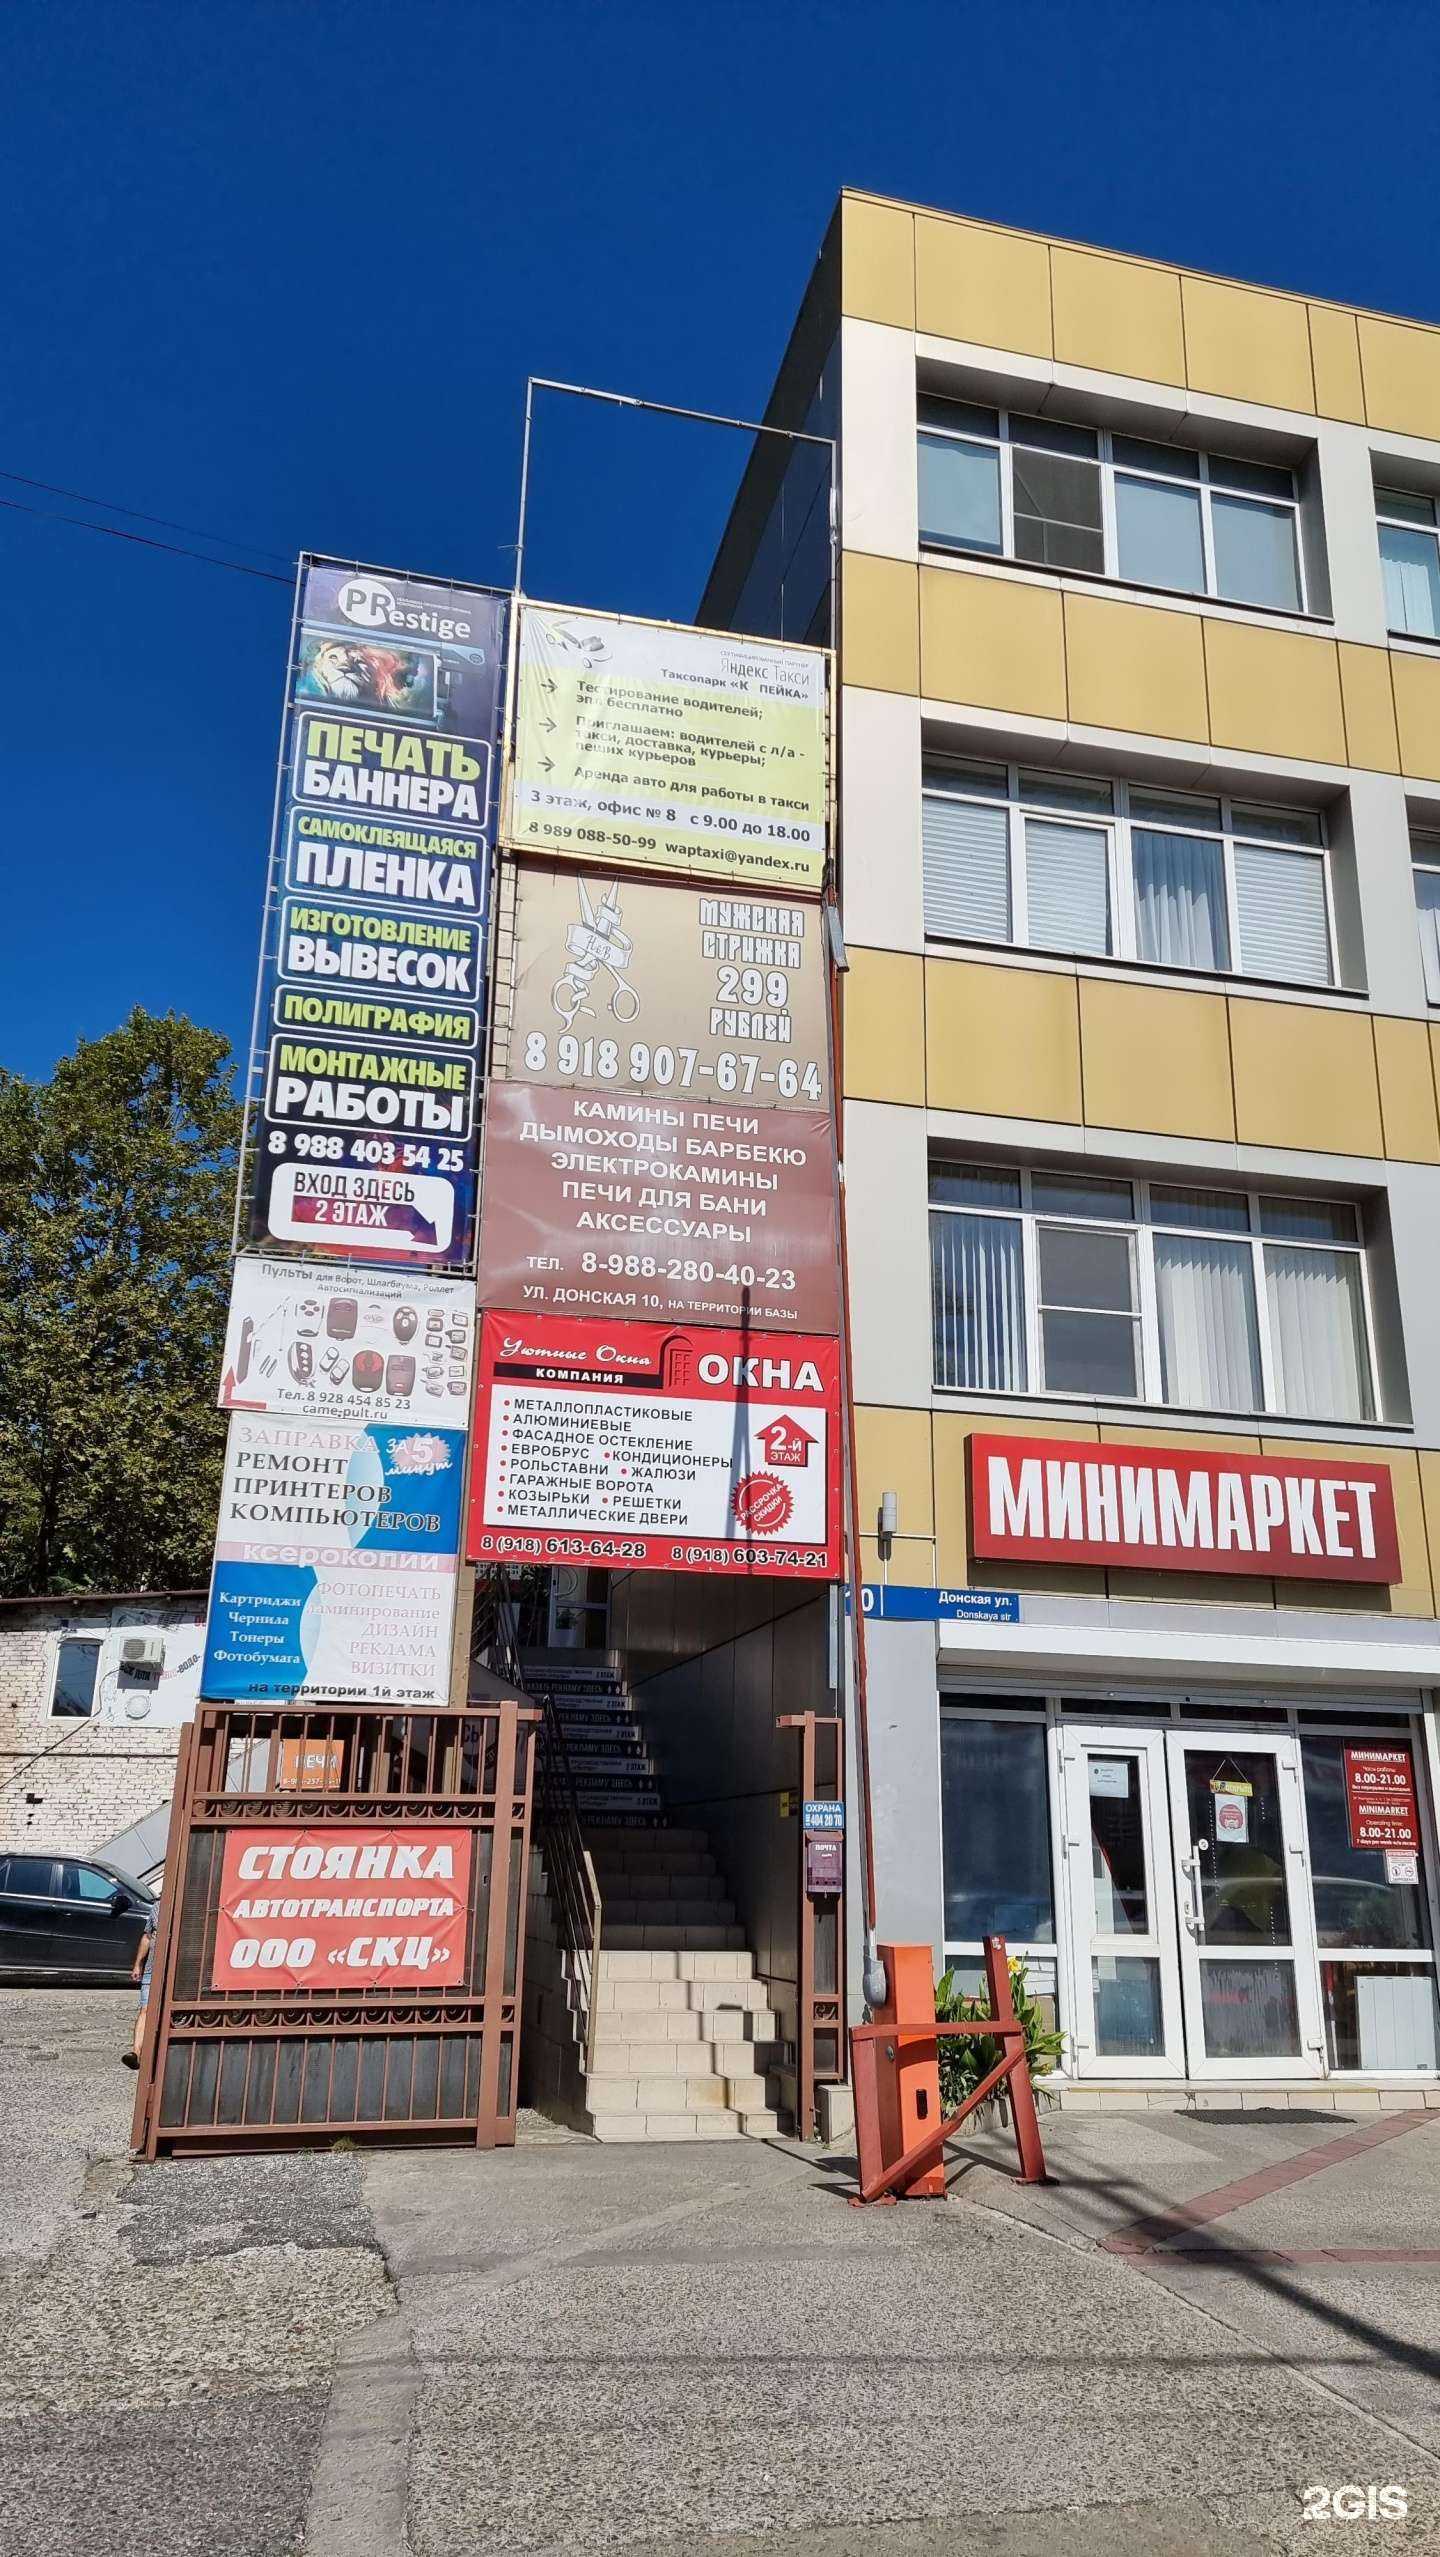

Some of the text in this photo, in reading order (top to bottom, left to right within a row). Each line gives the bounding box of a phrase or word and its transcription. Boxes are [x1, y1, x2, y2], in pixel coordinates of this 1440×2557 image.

[343, 587, 472, 639] PRestige
[662, 669, 726, 687] Таксопарк
[721, 658, 768, 679] Яндекс
[775, 666, 809, 685] Такси
[607, 697, 683, 717] бесплатно
[683, 697, 763, 720] водителей;
[307, 721, 481, 781] ПЕЧАТЬ
[625, 736, 765, 767] доставка, курьеры;
[629, 746, 696, 766] курьеров
[680, 731, 795, 758] водителей с л/а
[303, 760, 479, 821] БАННЕРА
[575, 767, 809, 812] Аренда авто для работы в такси
[531, 790, 810, 842] 3 этаж, офис № 8 с 9.00 до 18.00
[298, 816, 476, 859] САМОКЛЕЯЩАЯСЯ
[529, 821, 809, 872] 8 989 088-50-99 waptaxi@yandex.ru
[296, 841, 475, 907] ПЛЕНКА
[291, 907, 471, 952] ИЗГОТОВЛЕНИЕ
[699, 898, 804, 937] МУЖСКАЯ
[702, 931, 801, 969] СТРИЖКА
[288, 935, 471, 992] ВЫВЕСОК
[716, 965, 788, 1008] 299
[284, 995, 469, 1040] ПОЛИГРАФИЯ
[709, 1006, 792, 1043] РУБЛЕЙ
[280, 1045, 466, 1091] МОНТАЖНЫЕ
[525, 1030, 823, 1101] 8 918 907-67-64
[275, 1077, 463, 1132] РАБОТЫ
[574, 1100, 759, 1135] КАМИНЫ ПЕЧИ
[268, 1131, 464, 1172] 8 988 403 54 25
[520, 1121, 806, 1166] ДЫМОХОДЫ БАРБЕКЮ
[551, 1151, 778, 1190] ЭЛЕКТРОКАМИНЫ
[294, 1172, 415, 1202] ВХОД ЗДЕСЬ
[563, 1181, 766, 1216] ПЕЧИ ДЛЯ БАНИ
[315, 1200, 388, 1227] 2 ЭТАЖ
[576, 1211, 750, 1243] АКСЕССУАРЫ
[262, 1264, 312, 1279] Пульты
[316, 1274, 333, 1282] для
[527, 1252, 796, 1290] ТЕЛ. 8-988-280-40-23
[523, 1285, 798, 1319] УЛ. ДОНСКАЯ 10, НА ТЕРРИТОРИИ БАЗЫ
[500, 1337, 587, 1360] Уютные
[536, 1368, 623, 1383] КОМПАНИЯ
[698, 1354, 825, 1392] ОКНА
[307, 1391, 315, 1401] 8
[320, 1392, 343, 1404] 928
[347, 1395, 371, 1406] 454
[375, 1398, 390, 1407] 85
[395, 1399, 410, 1409] 23
[514, 1399, 693, 1421] МЕТАЛЛОПЛАСТИКОВЫЕ
[513, 1414, 632, 1432] АЛЮМИНИЕВЫЕ
[239, 1426, 379, 1453] ЗАПРАВКА
[412, 1438, 433, 1463] 5
[512, 1429, 693, 1451] ФАСАДНОЕ ОСТЕКЛЕНИЕ
[236, 1452, 348, 1474] РЕМОНТ
[385, 1459, 453, 1476] минут
[512, 1444, 733, 1468] ЕВРОБРУС КОНДИЦИОНЕРЫ
[771, 1451, 801, 1462] ЭТАЖ
[511, 1459, 696, 1480] РОЛЬСТАВНИ ЖАЛЮЗИ
[233, 1478, 392, 1504] ПРИНТЕРОВ
[510, 1474, 653, 1493] ГАРАЖНЫЕ ВОРОТА
[509, 1489, 681, 1510] КОЗЫРЬКИ РЕШЕТКИ
[740, 1484, 782, 1520] РАССРОЧКА
[754, 1496, 782, 1521] СКИДКИ
[987, 1455, 1376, 1560] МИНИМАРКЕТ
[230, 1503, 440, 1532] КОМПЬЮТЕРОВ
[508, 1505, 688, 1525] МЕТАЛЛИЧЕСКИЕ ДВЕРИ
[481, 1536, 827, 1568] 8 (918) 613-64-28 8 (918) 603-74-21
[220, 1592, 300, 1608] Картриджи
[317, 1582, 440, 1599] ФОТОПЕЧАТЬ
[939, 1592, 1012, 1608] Донская ул.
[228, 1612, 289, 1626] Чернила
[957, 1610, 998, 1621] Donskaya
[230, 1631, 284, 1645] Тонеры
[360, 1622, 439, 1638] ДИЗАЙН
[214, 1651, 300, 1666] Фотобумага
[349, 1642, 436, 1657] РЕКЛАМА
[352, 1662, 435, 1676] ВИЗИТКИ
[249, 1682, 434, 1700] на территории 1й этаж
[1351, 1751, 1405, 1761] МИНИМАРКЕТ
[1355, 1773, 1406, 1784] 8.00-21.00
[805, 1804, 841, 1813] ОХРАНА
[1359, 1805, 1408, 1815] MINIMARKET
[1360, 1827, 1411, 1839] 8.00-21.00
[238, 1845, 454, 1881] СТОЯНКА
[233, 1897, 454, 1919] АВТОТРАНСПОРТА
[229, 1936, 450, 1971] ООО «СКЦ»
